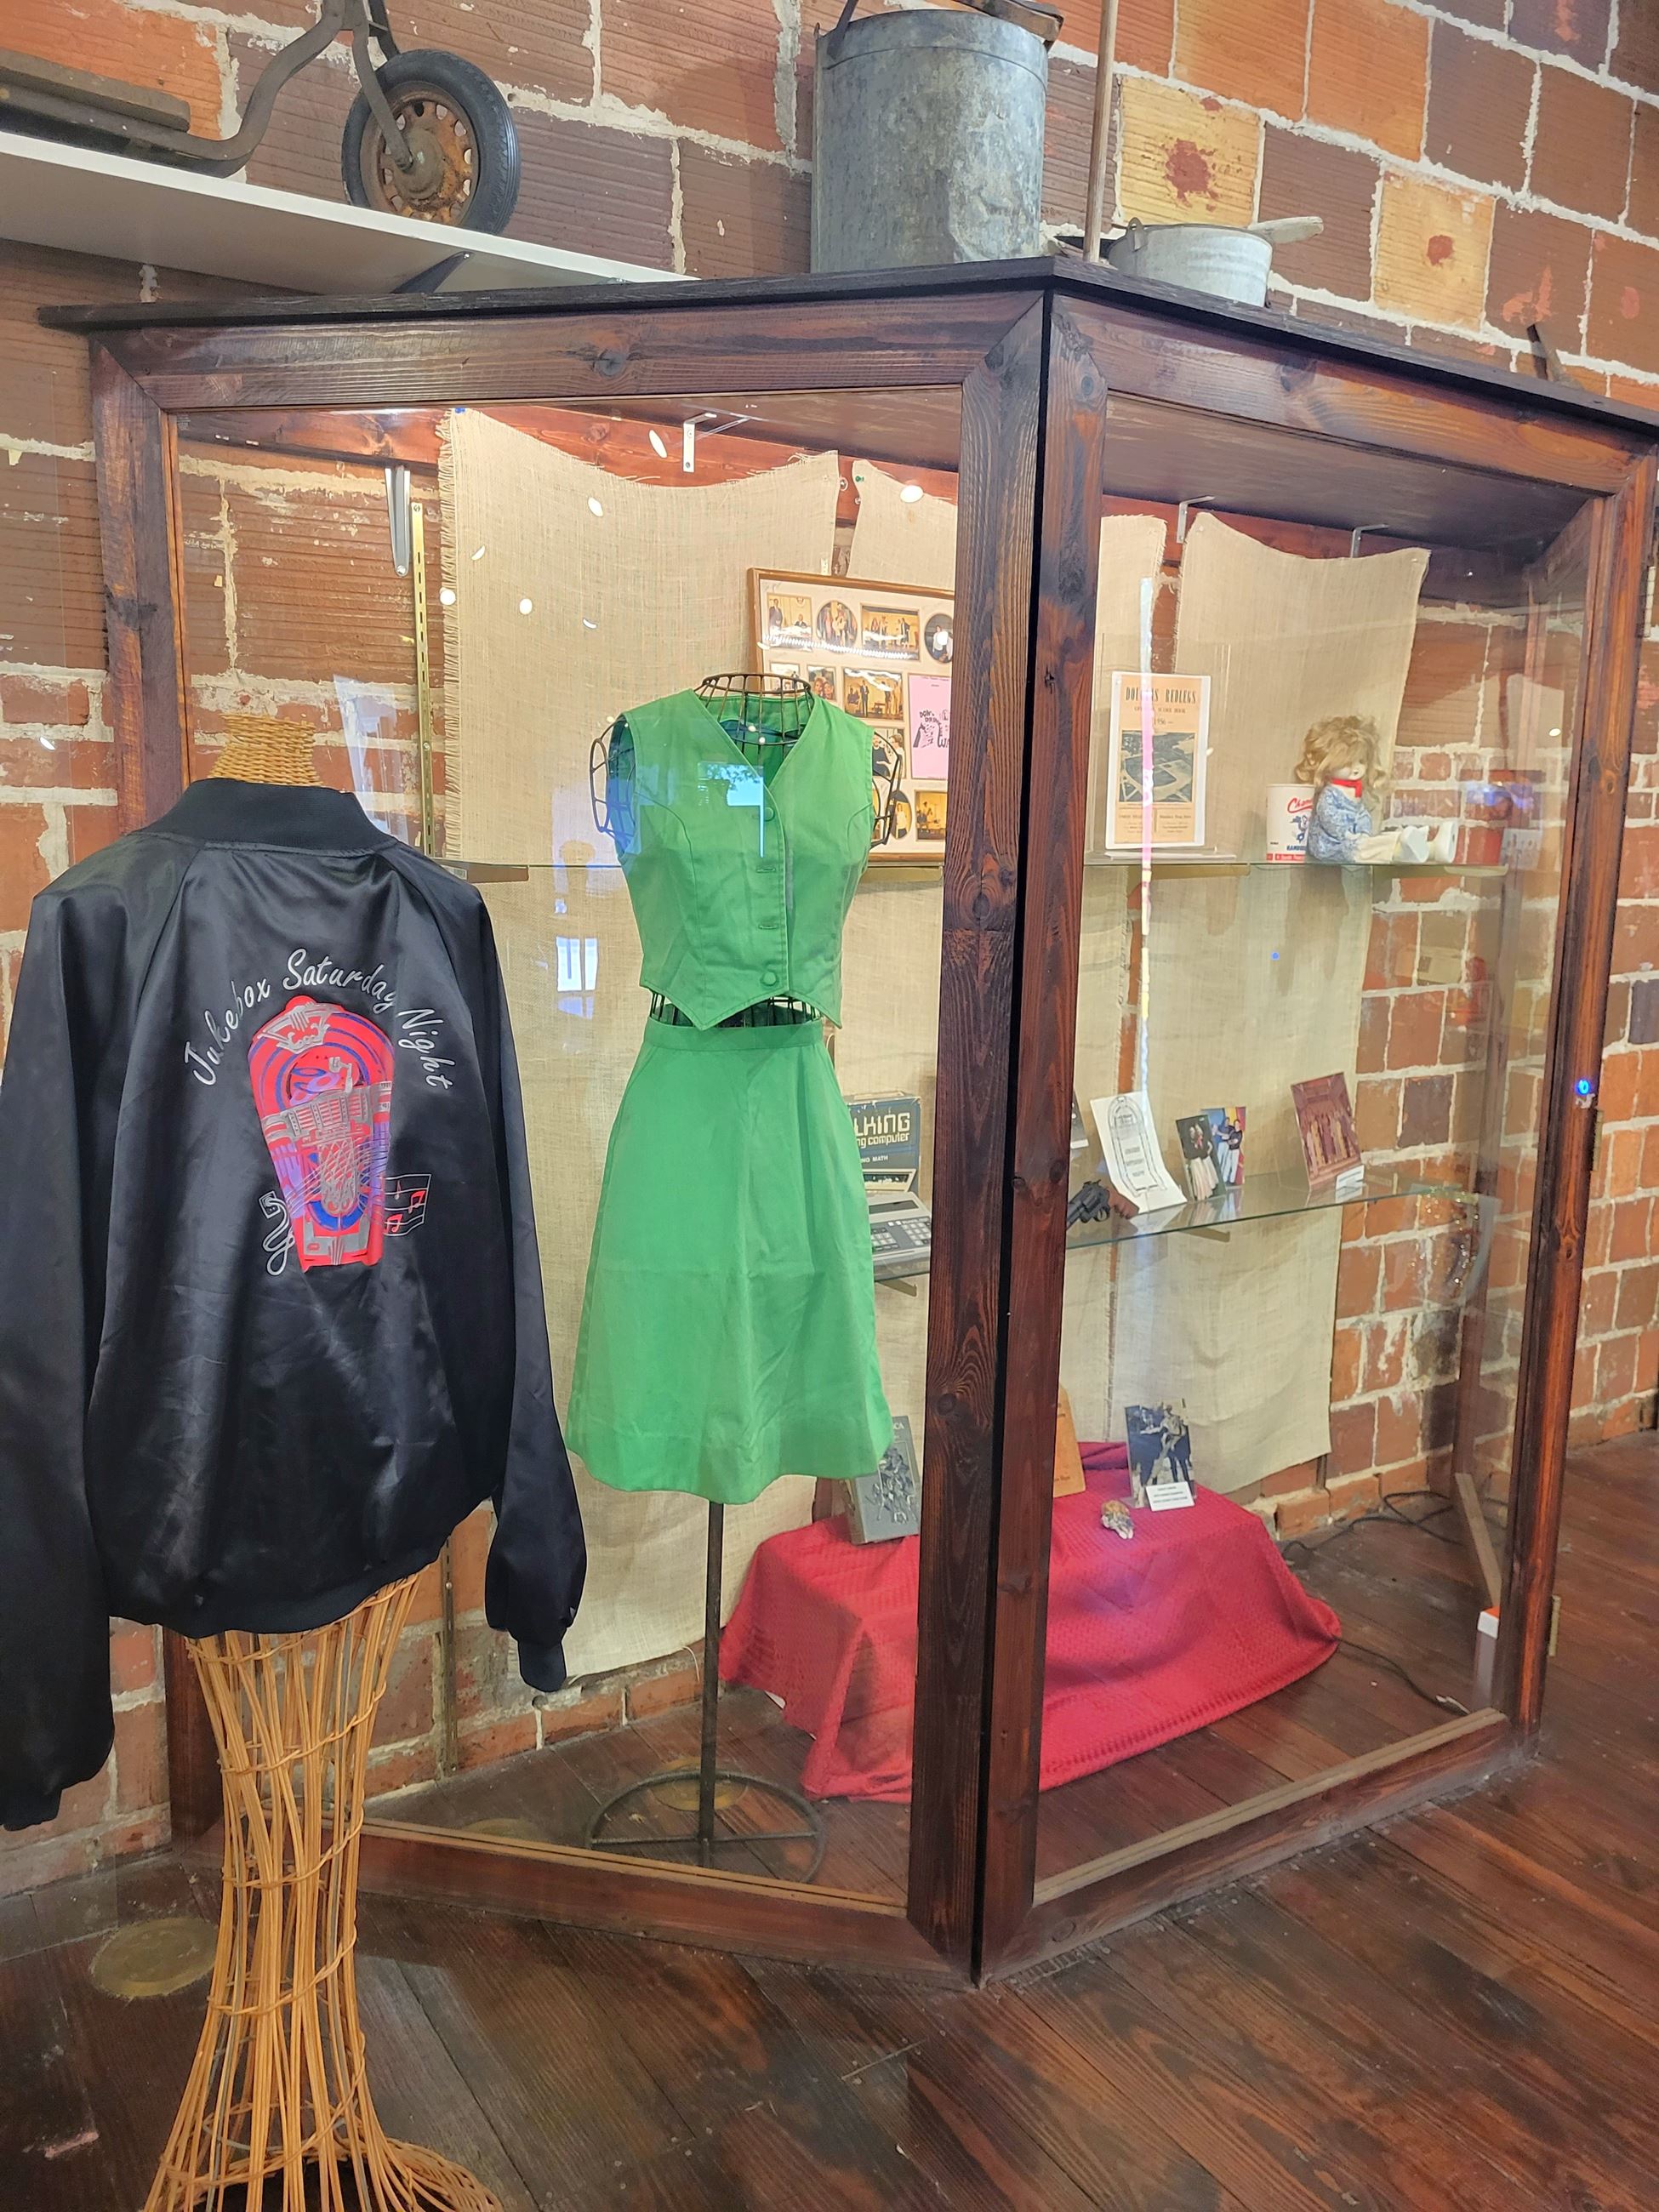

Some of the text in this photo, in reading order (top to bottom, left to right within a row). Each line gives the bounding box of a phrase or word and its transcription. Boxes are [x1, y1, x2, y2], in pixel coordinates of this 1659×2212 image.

[184, 948, 456, 1090] Jukebox Saturday Night
[868, 1132, 910, 1146] computer
